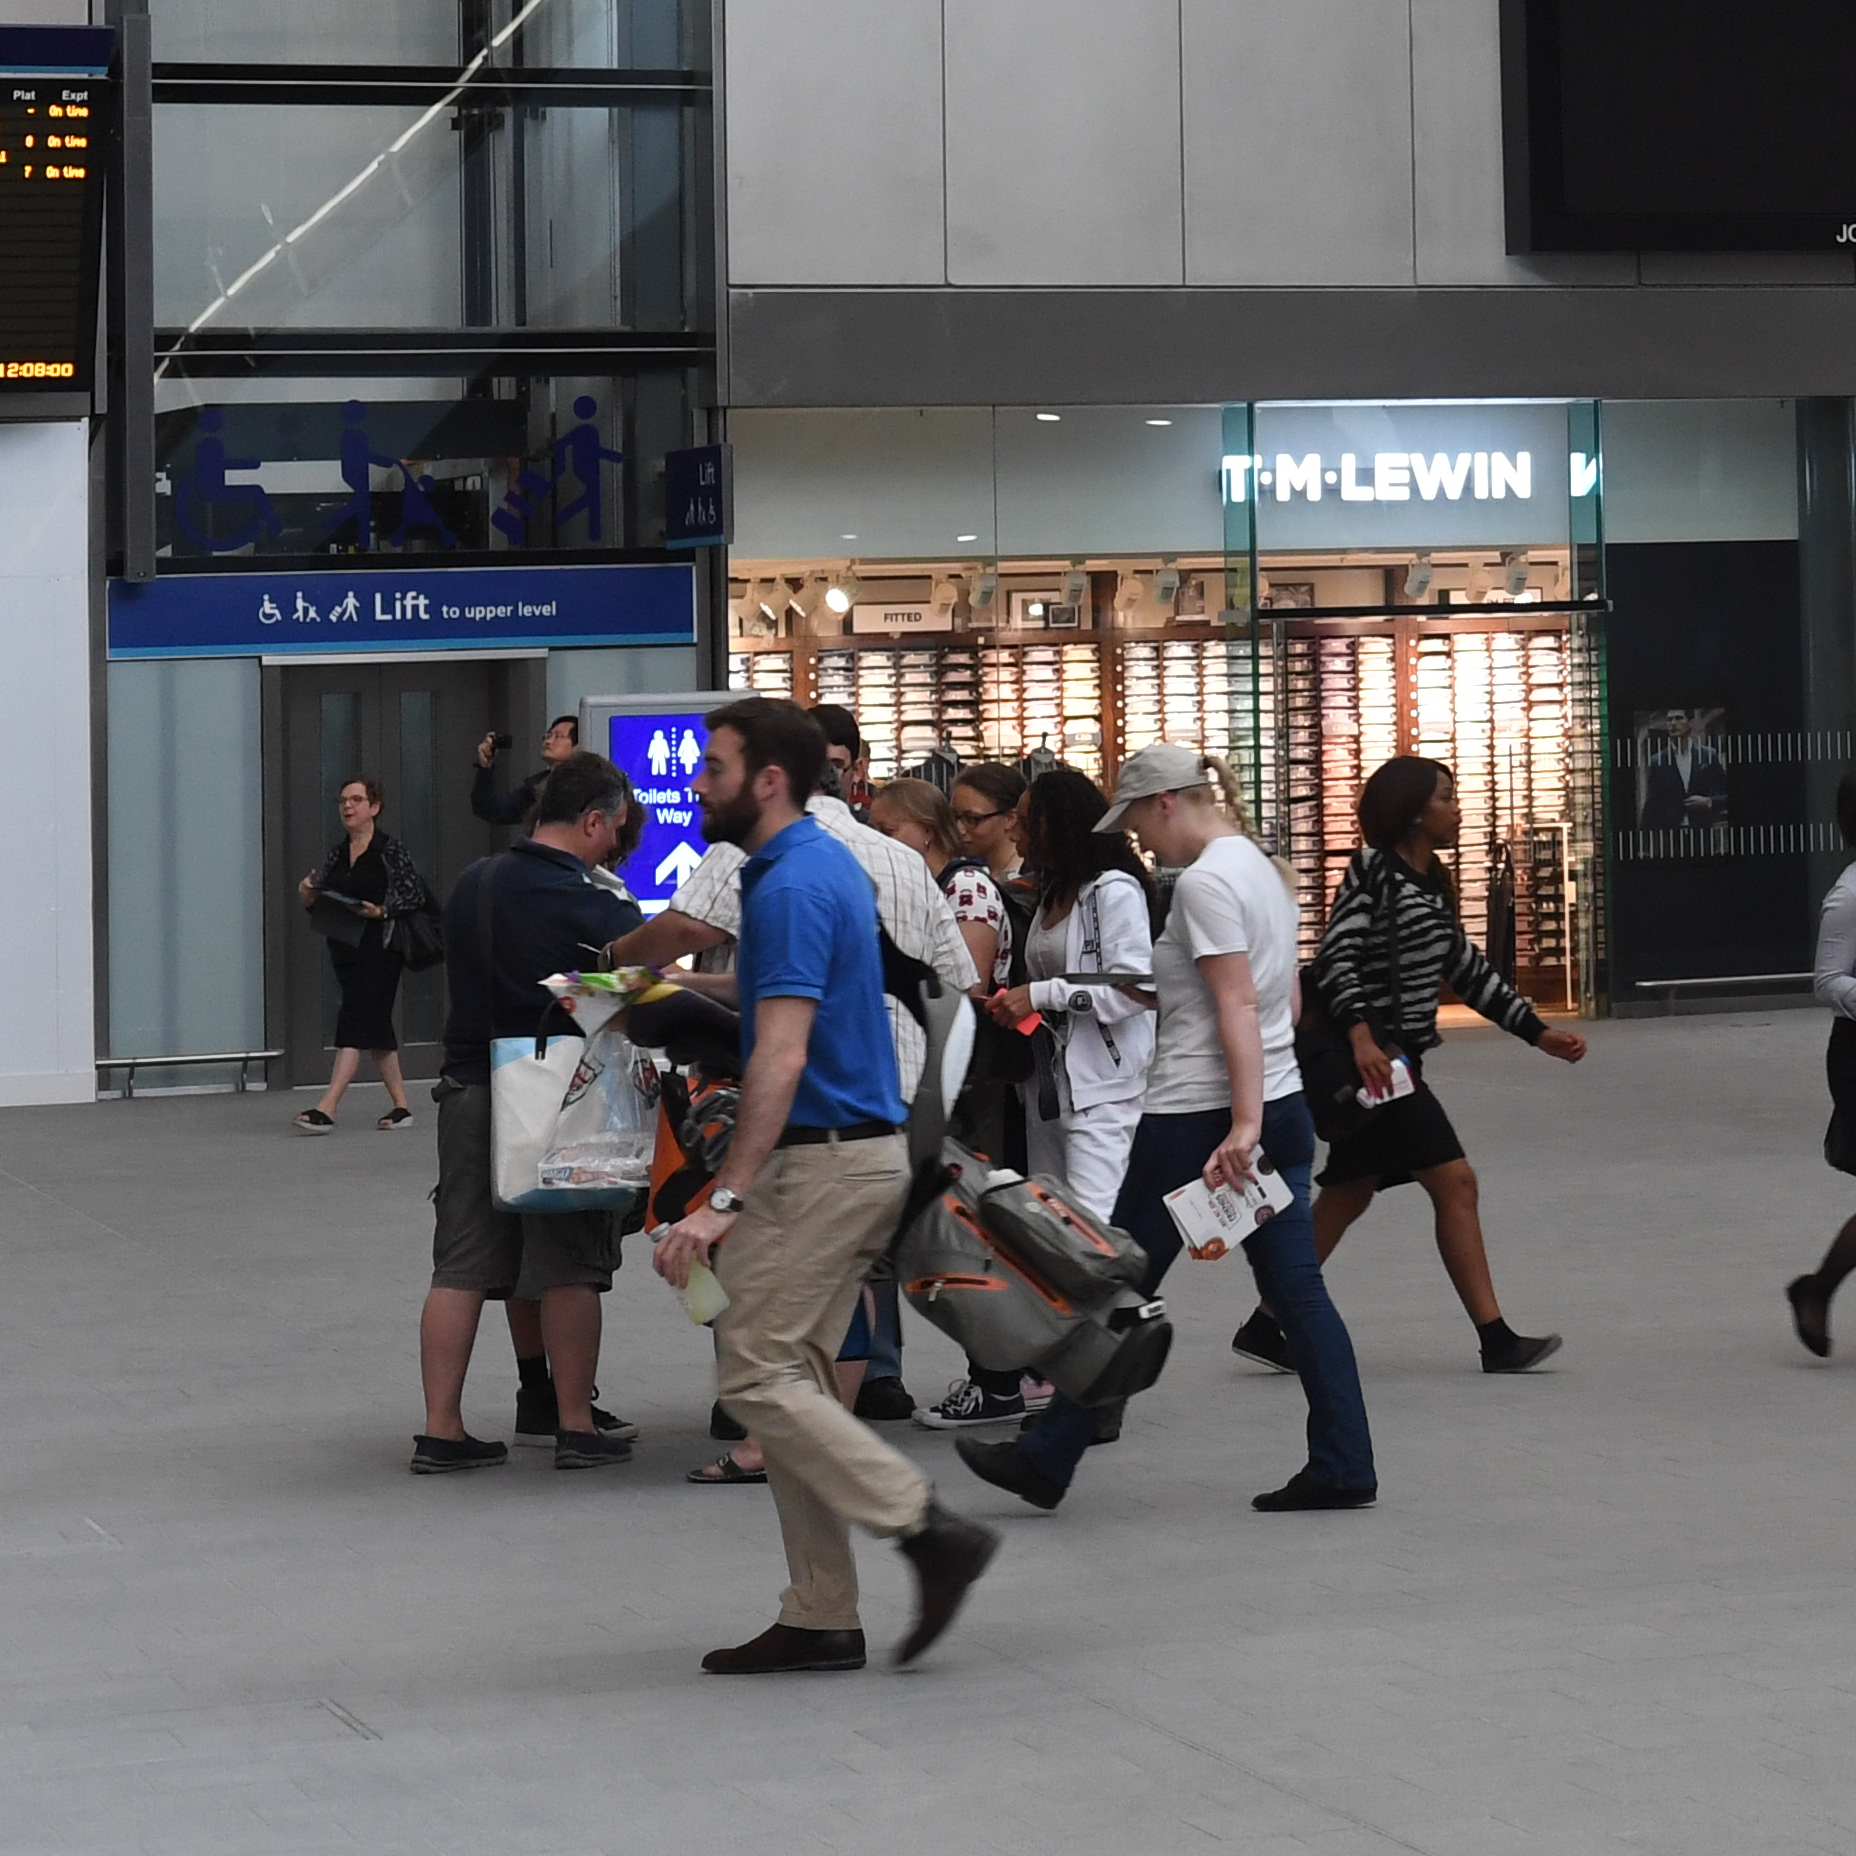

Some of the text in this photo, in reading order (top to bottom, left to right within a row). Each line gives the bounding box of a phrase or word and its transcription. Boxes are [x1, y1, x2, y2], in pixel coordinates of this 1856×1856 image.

[13, 90, 89, 103] Plat Expt
[49, 105, 63, 117] On
[48, 135, 62, 148] On
[24, 165, 33, 178] 7
[46, 166, 60, 178] On
[374, 591, 557, 621] Lift to upper level
[883, 612, 922, 623] FITTED
[656, 808, 693, 827] Way
